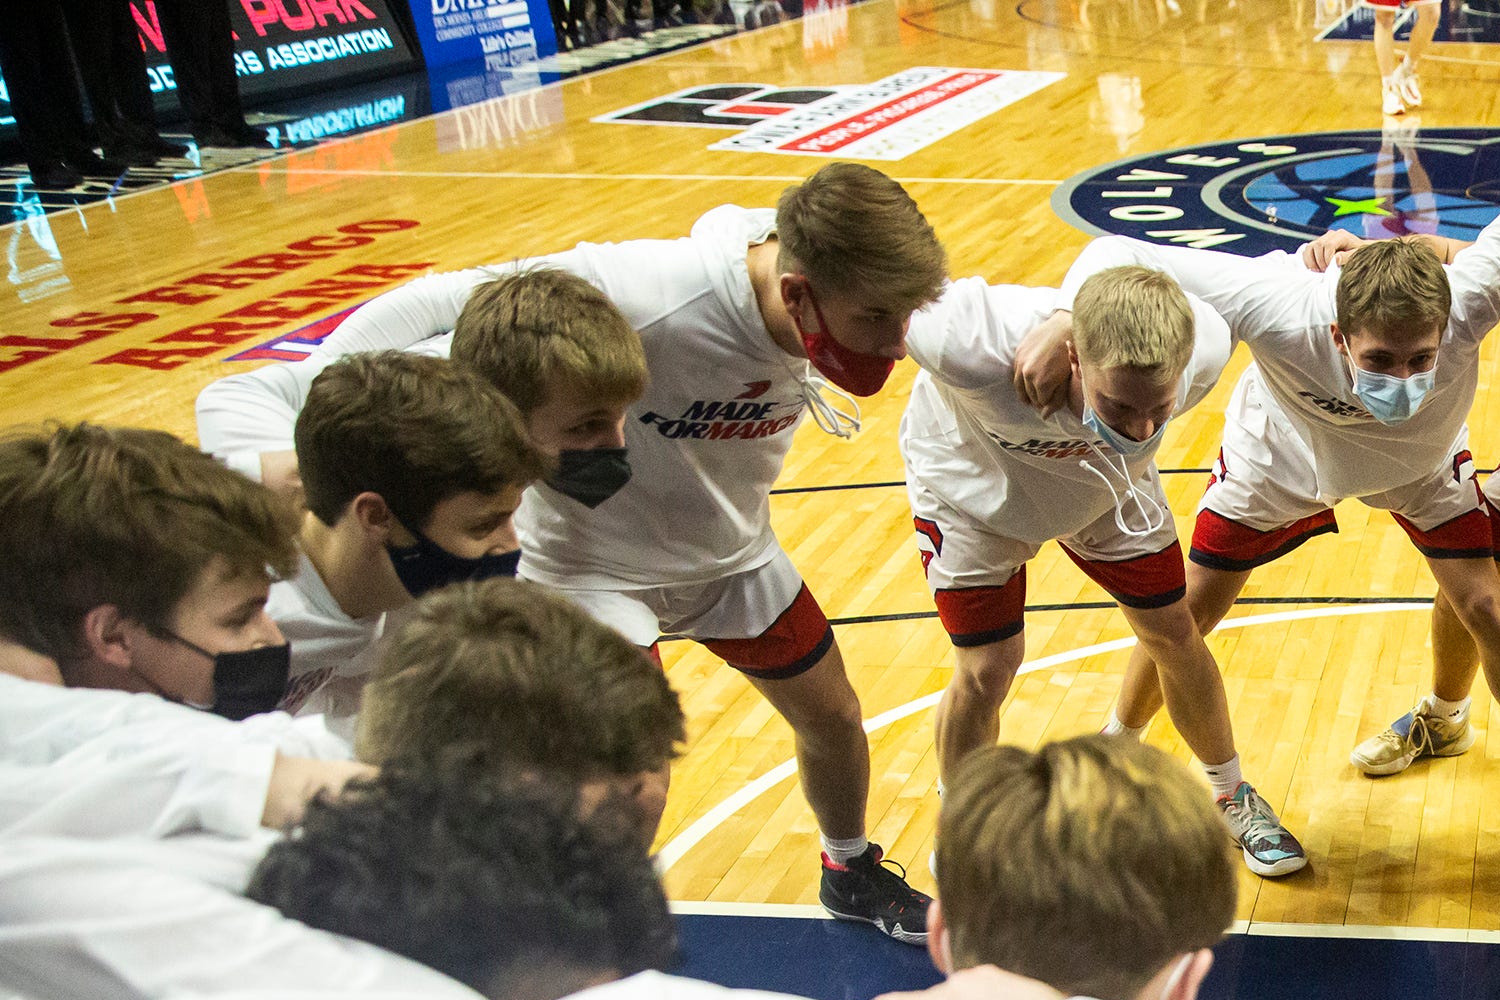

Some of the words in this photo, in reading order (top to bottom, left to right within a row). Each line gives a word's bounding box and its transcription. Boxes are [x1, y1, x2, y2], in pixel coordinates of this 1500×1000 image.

[266, 27, 394, 70] ASSOCIATION
[1101, 142, 1297, 249] WOLVES
[113, 219, 421, 306] FARGO
[90, 262, 437, 371] ARENA
[681, 400, 779, 420] MADE
